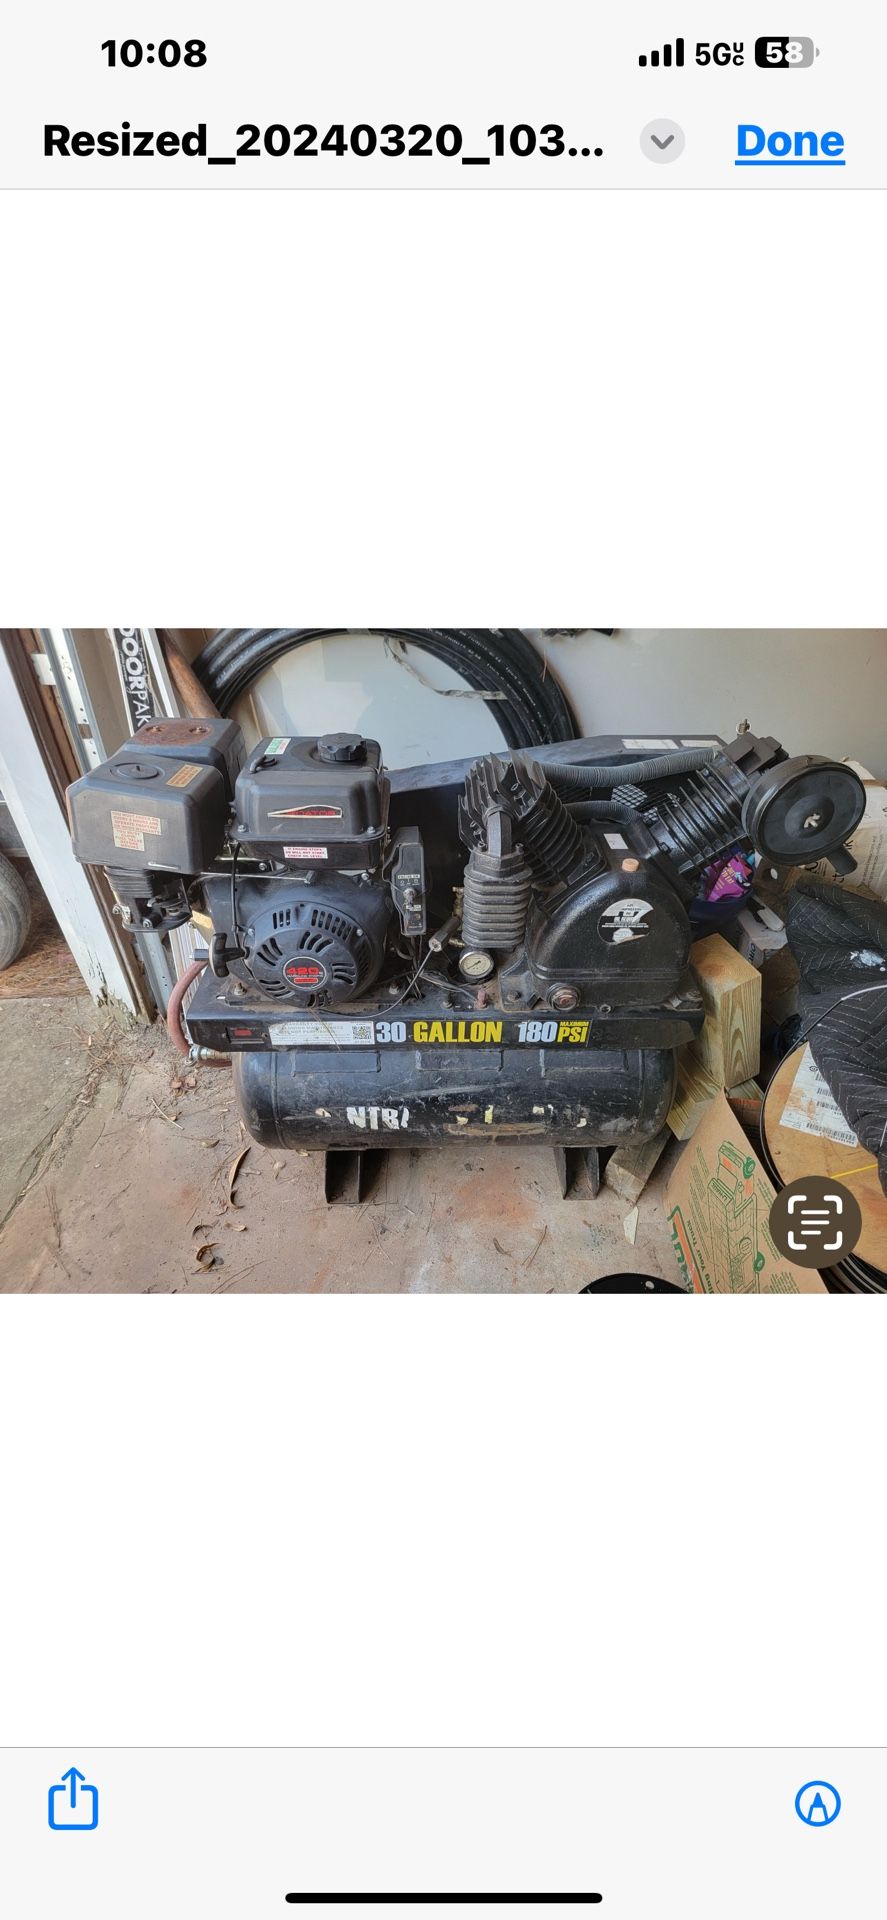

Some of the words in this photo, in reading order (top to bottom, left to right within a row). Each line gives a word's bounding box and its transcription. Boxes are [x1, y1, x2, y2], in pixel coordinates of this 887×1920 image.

[376, 1021, 407, 1043] 30
[413, 1021, 503, 1043] GALLON
[518, 1021, 558, 1043] 180
[557, 1026, 588, 1043] PSI
